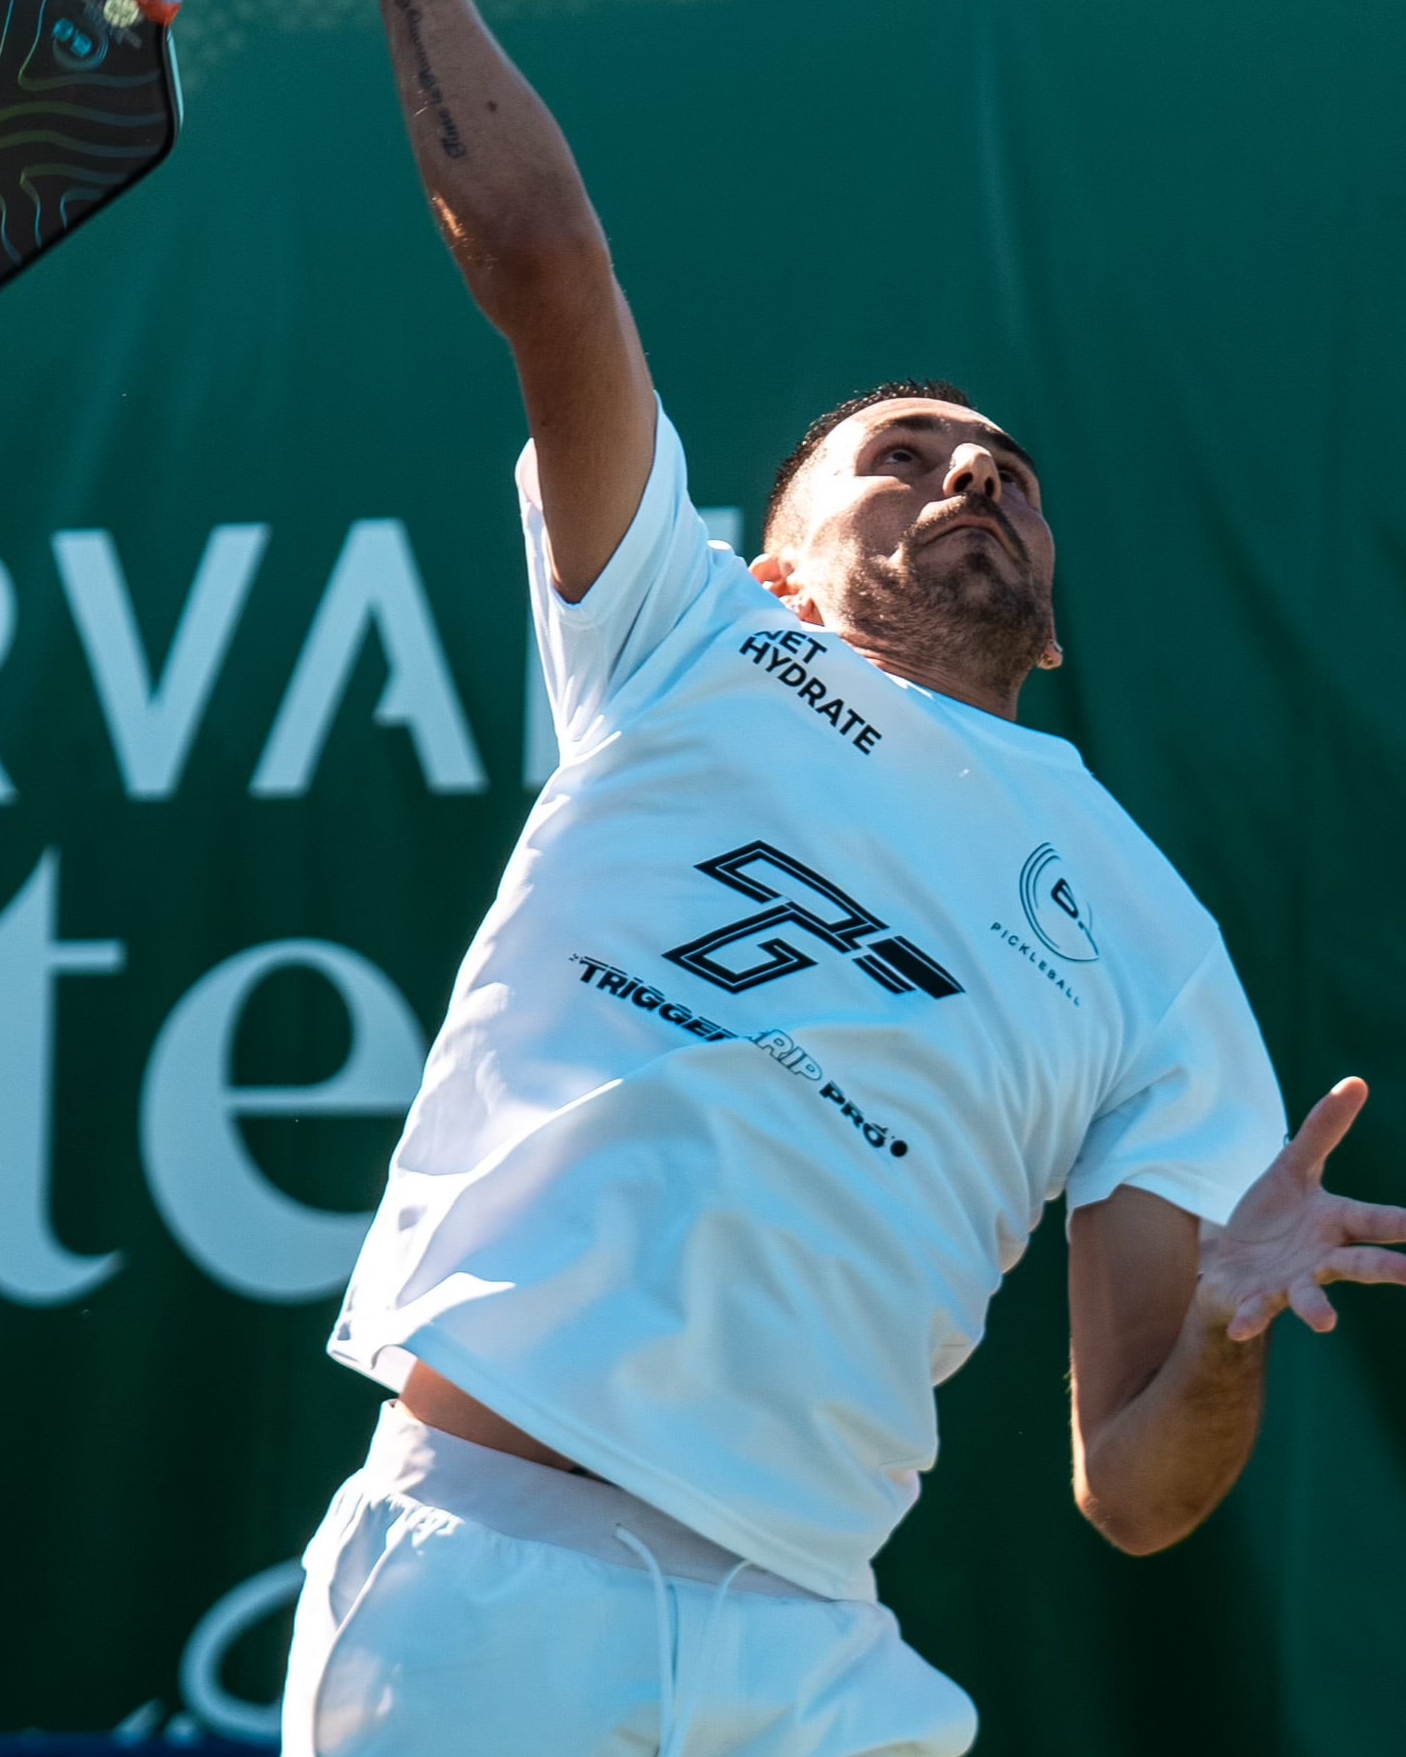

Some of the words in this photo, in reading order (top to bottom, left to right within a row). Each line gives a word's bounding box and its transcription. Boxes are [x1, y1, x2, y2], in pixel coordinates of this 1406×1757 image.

[738, 635, 883, 756] HYDRATE
[989, 921, 1081, 1007] PICKLEBALL
[747, 1027, 823, 1082] RIP
